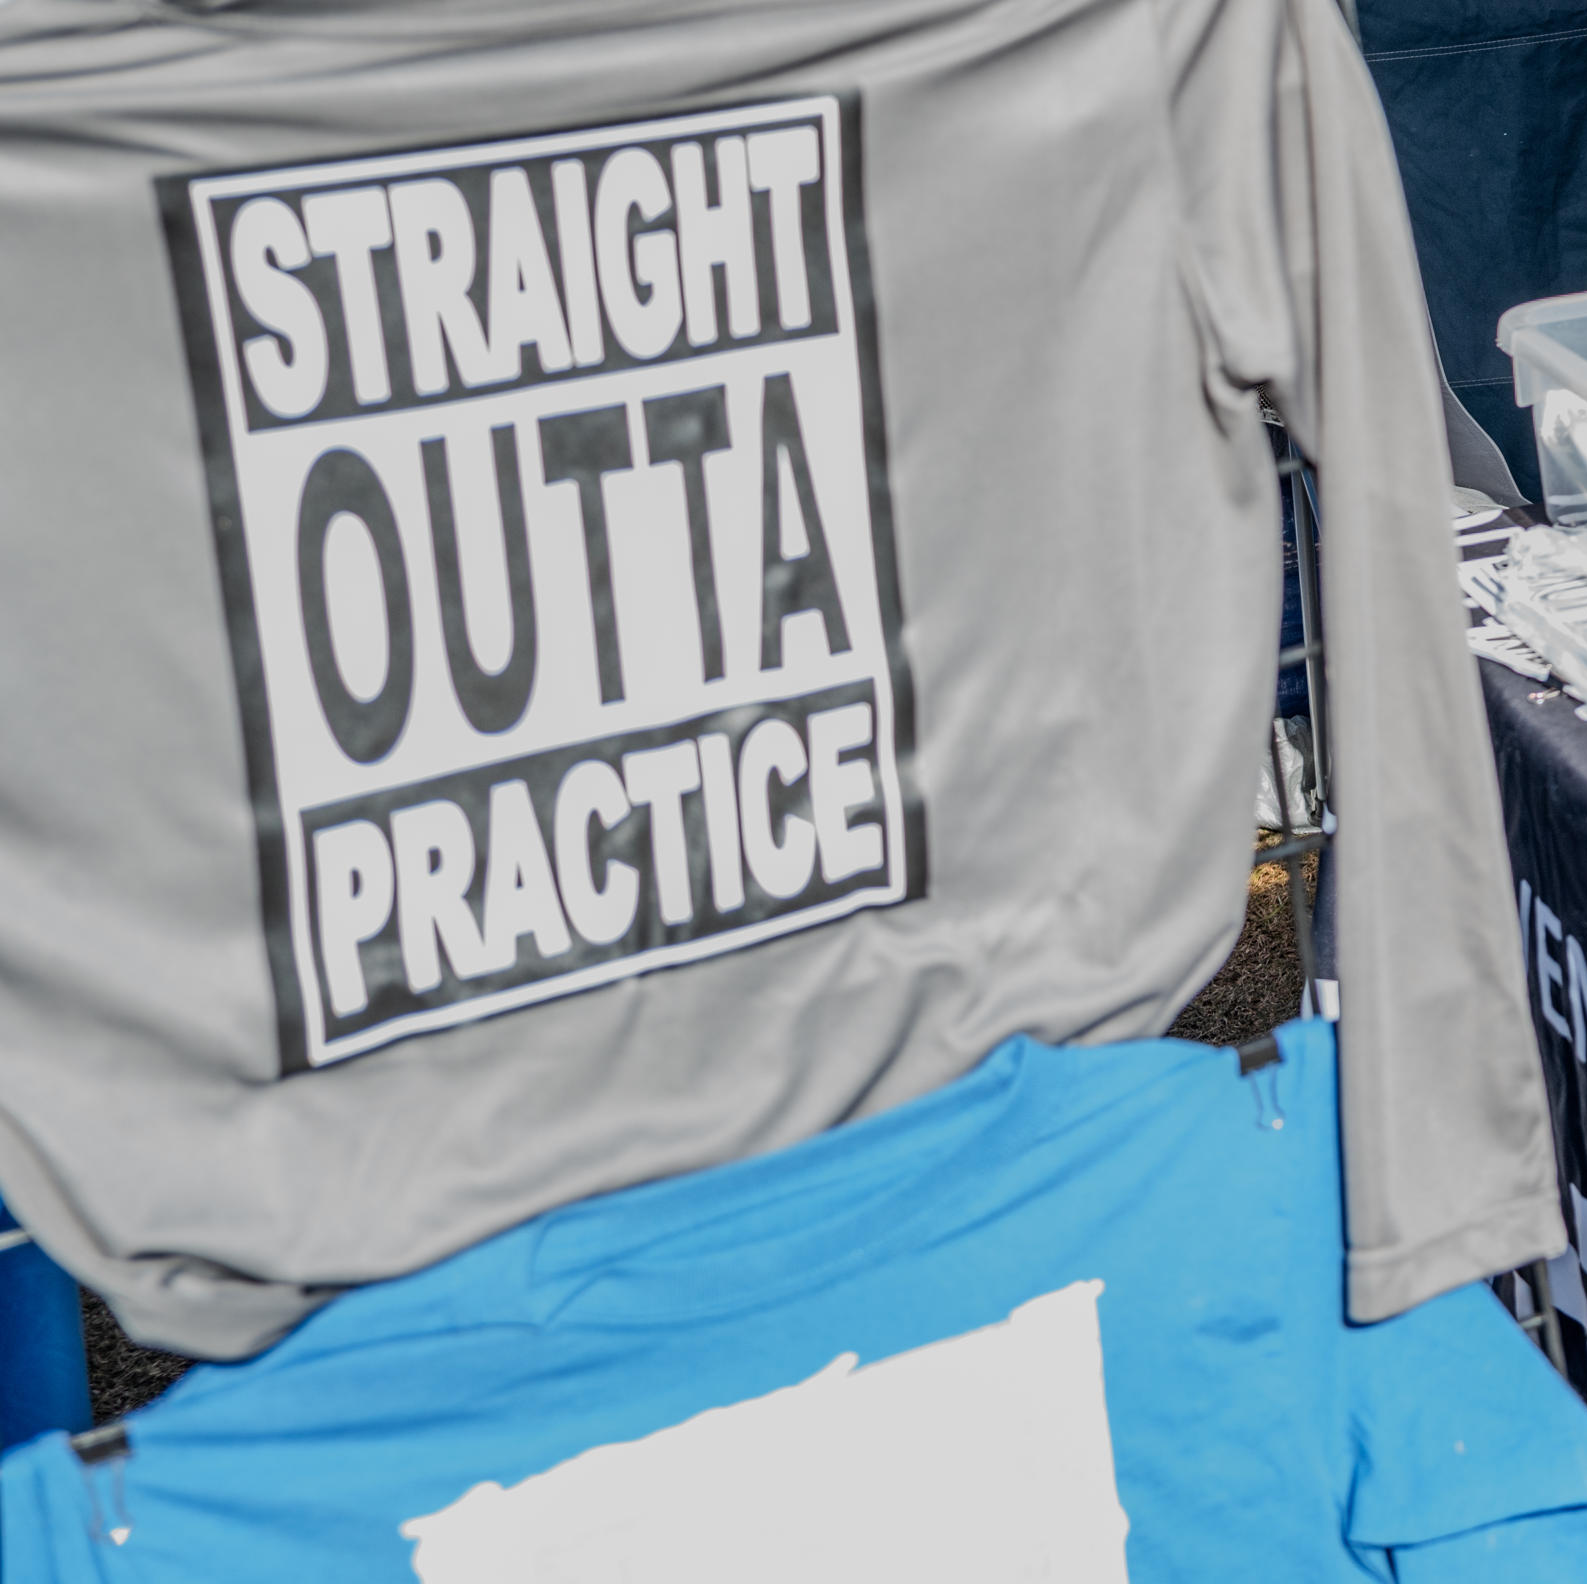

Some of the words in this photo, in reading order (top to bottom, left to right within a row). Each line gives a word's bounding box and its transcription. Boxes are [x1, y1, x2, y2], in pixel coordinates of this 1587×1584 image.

[228, 124, 823, 420] STRAIGHT
[295, 371, 854, 766] OUTTA
[312, 701, 886, 1018] PRACTICE
